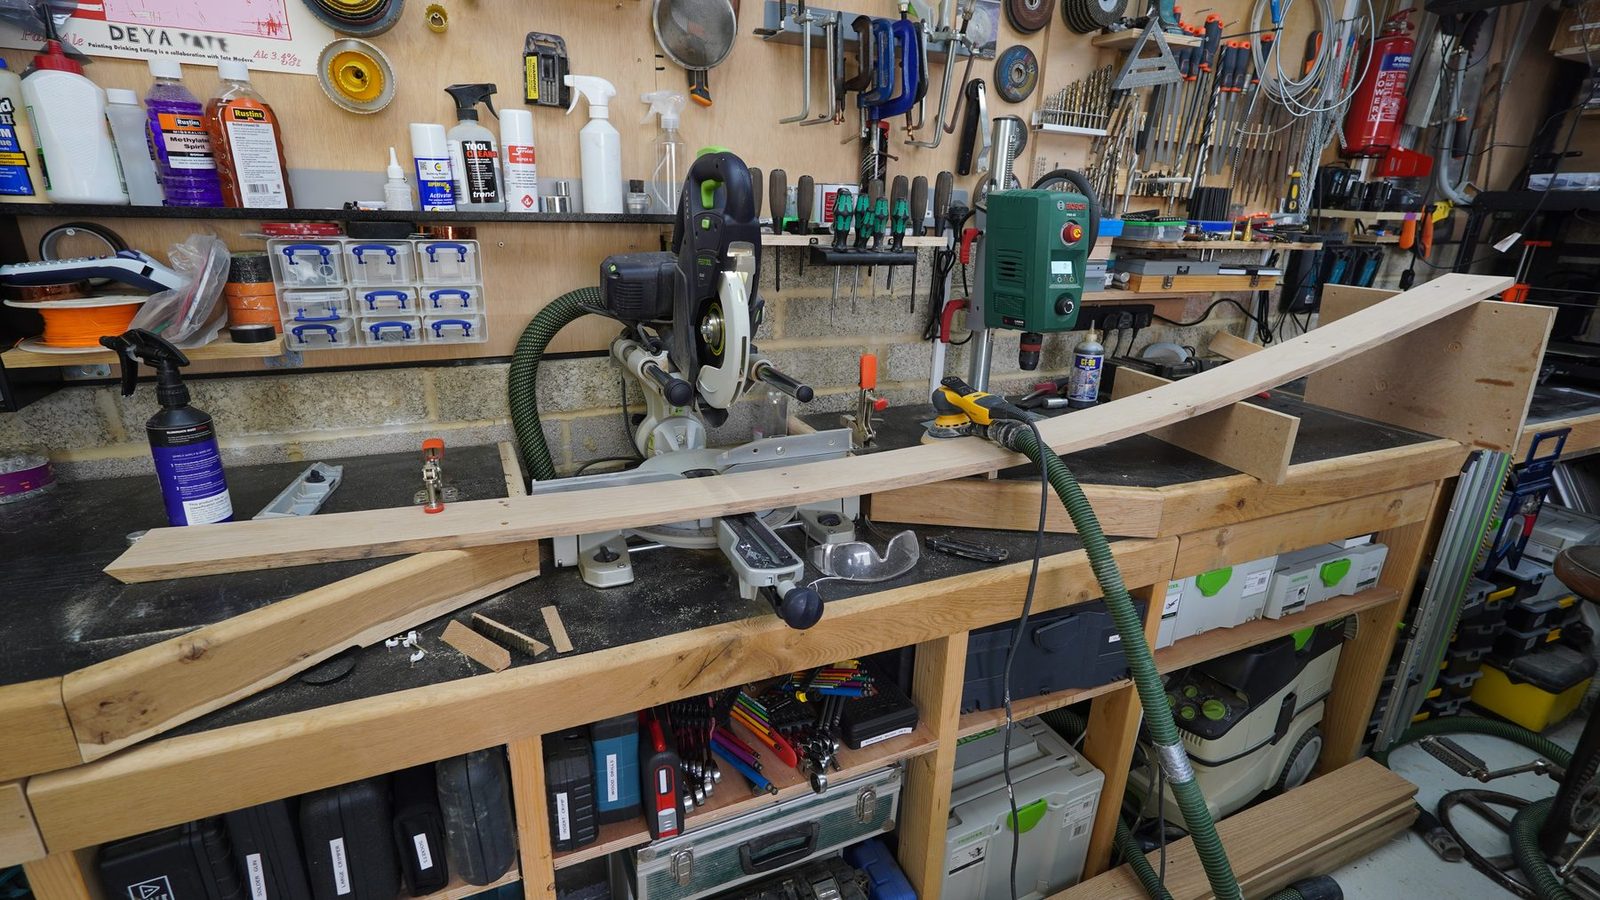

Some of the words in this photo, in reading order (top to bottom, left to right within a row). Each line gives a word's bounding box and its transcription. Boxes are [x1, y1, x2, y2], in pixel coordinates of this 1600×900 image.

[62, 33, 84, 46] Ale
[108, 24, 173, 47] DEYA
[179, 32, 228, 52] TATE
[114, 45, 138, 53] Drinking
[170, 50, 205, 58] collaboration
[253, 50, 268, 59] Alc
[234, 109, 264, 118] Rustins
[465, 143, 488, 151] TOOL
[419, 840, 428, 864] SOCKETS
